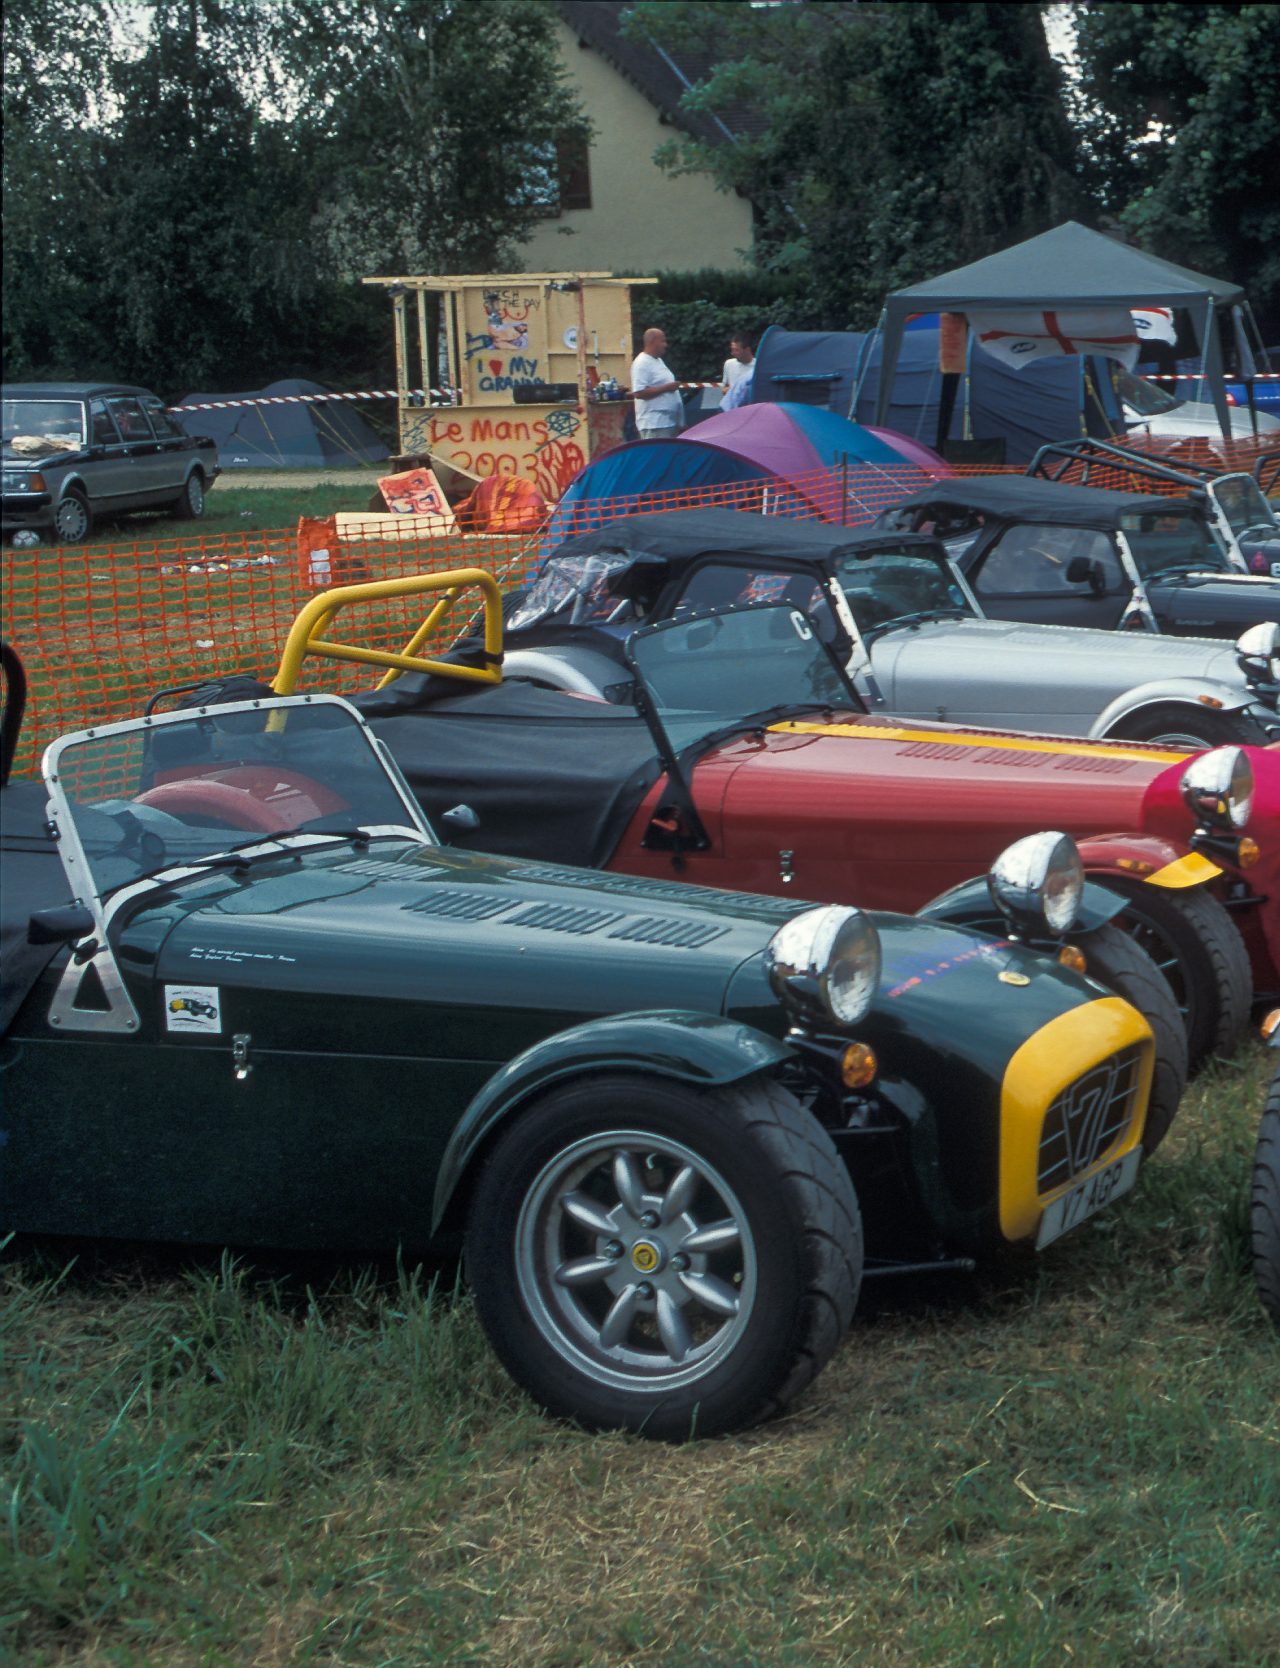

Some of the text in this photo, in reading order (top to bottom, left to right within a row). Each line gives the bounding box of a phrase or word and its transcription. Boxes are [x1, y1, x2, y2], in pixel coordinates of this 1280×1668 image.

[509, 356, 538, 377] MY
[431, 418, 549, 447] Le Mans
[450, 450, 539, 484] 2003
[1067, 1063, 1115, 1169] 7
